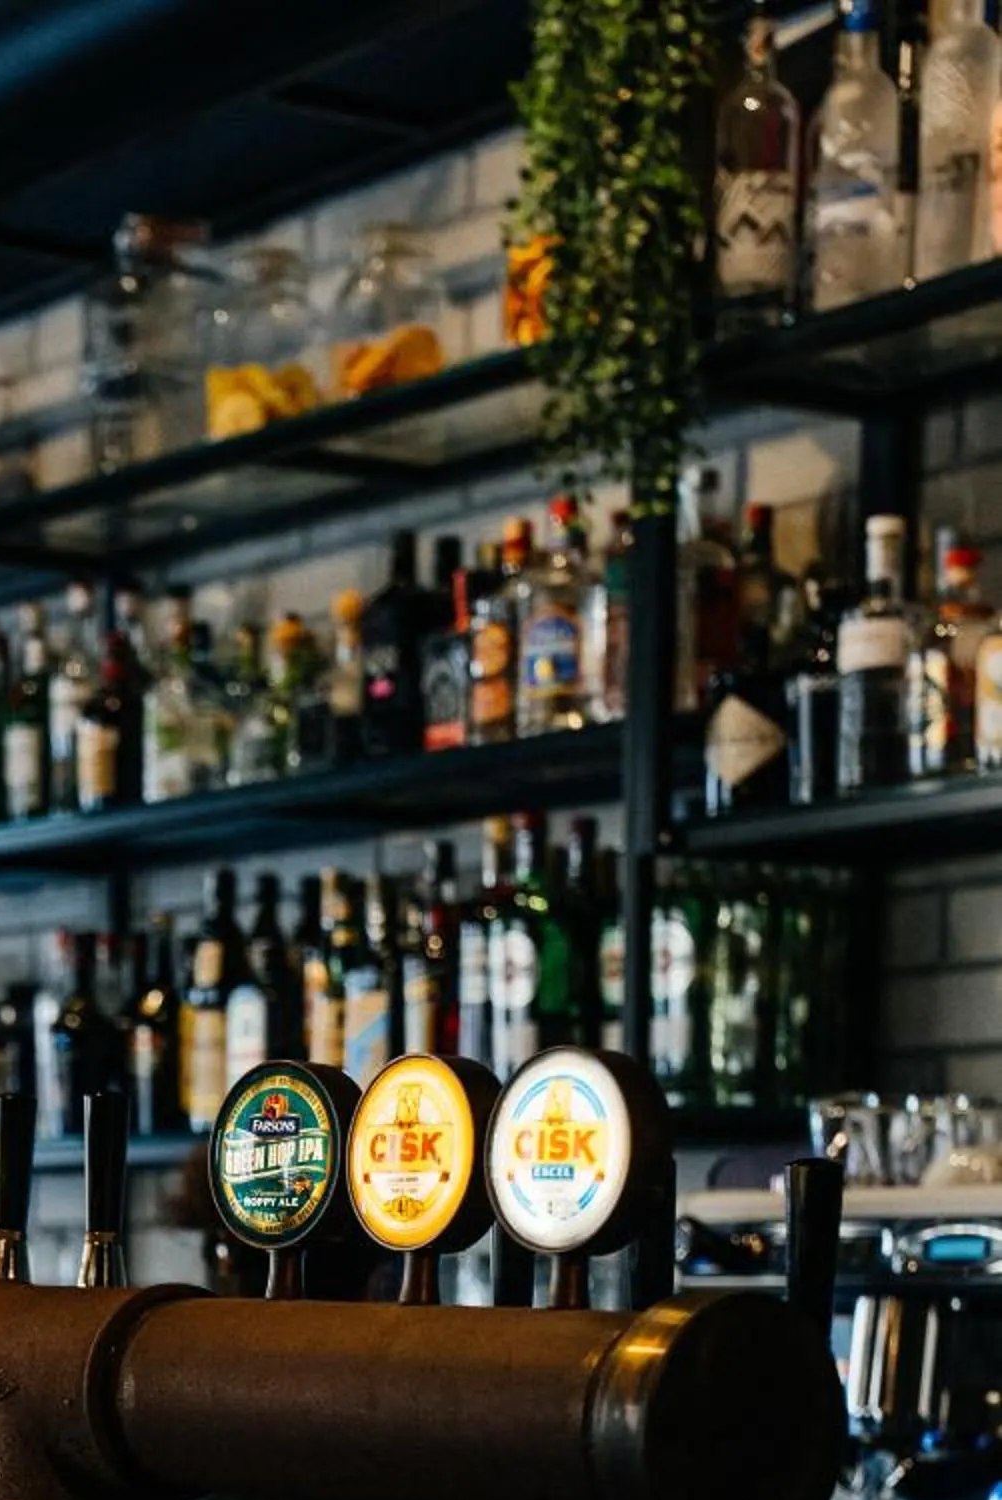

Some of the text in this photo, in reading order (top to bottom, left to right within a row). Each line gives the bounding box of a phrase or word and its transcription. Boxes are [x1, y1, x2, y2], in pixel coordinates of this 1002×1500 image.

[252, 1119, 296, 1133] FARSONS
[297, 1136, 324, 1163] IPA
[369, 1130, 443, 1165] CISK
[514, 1128, 597, 1165] CISK
[278, 1196, 299, 1207] ALE
